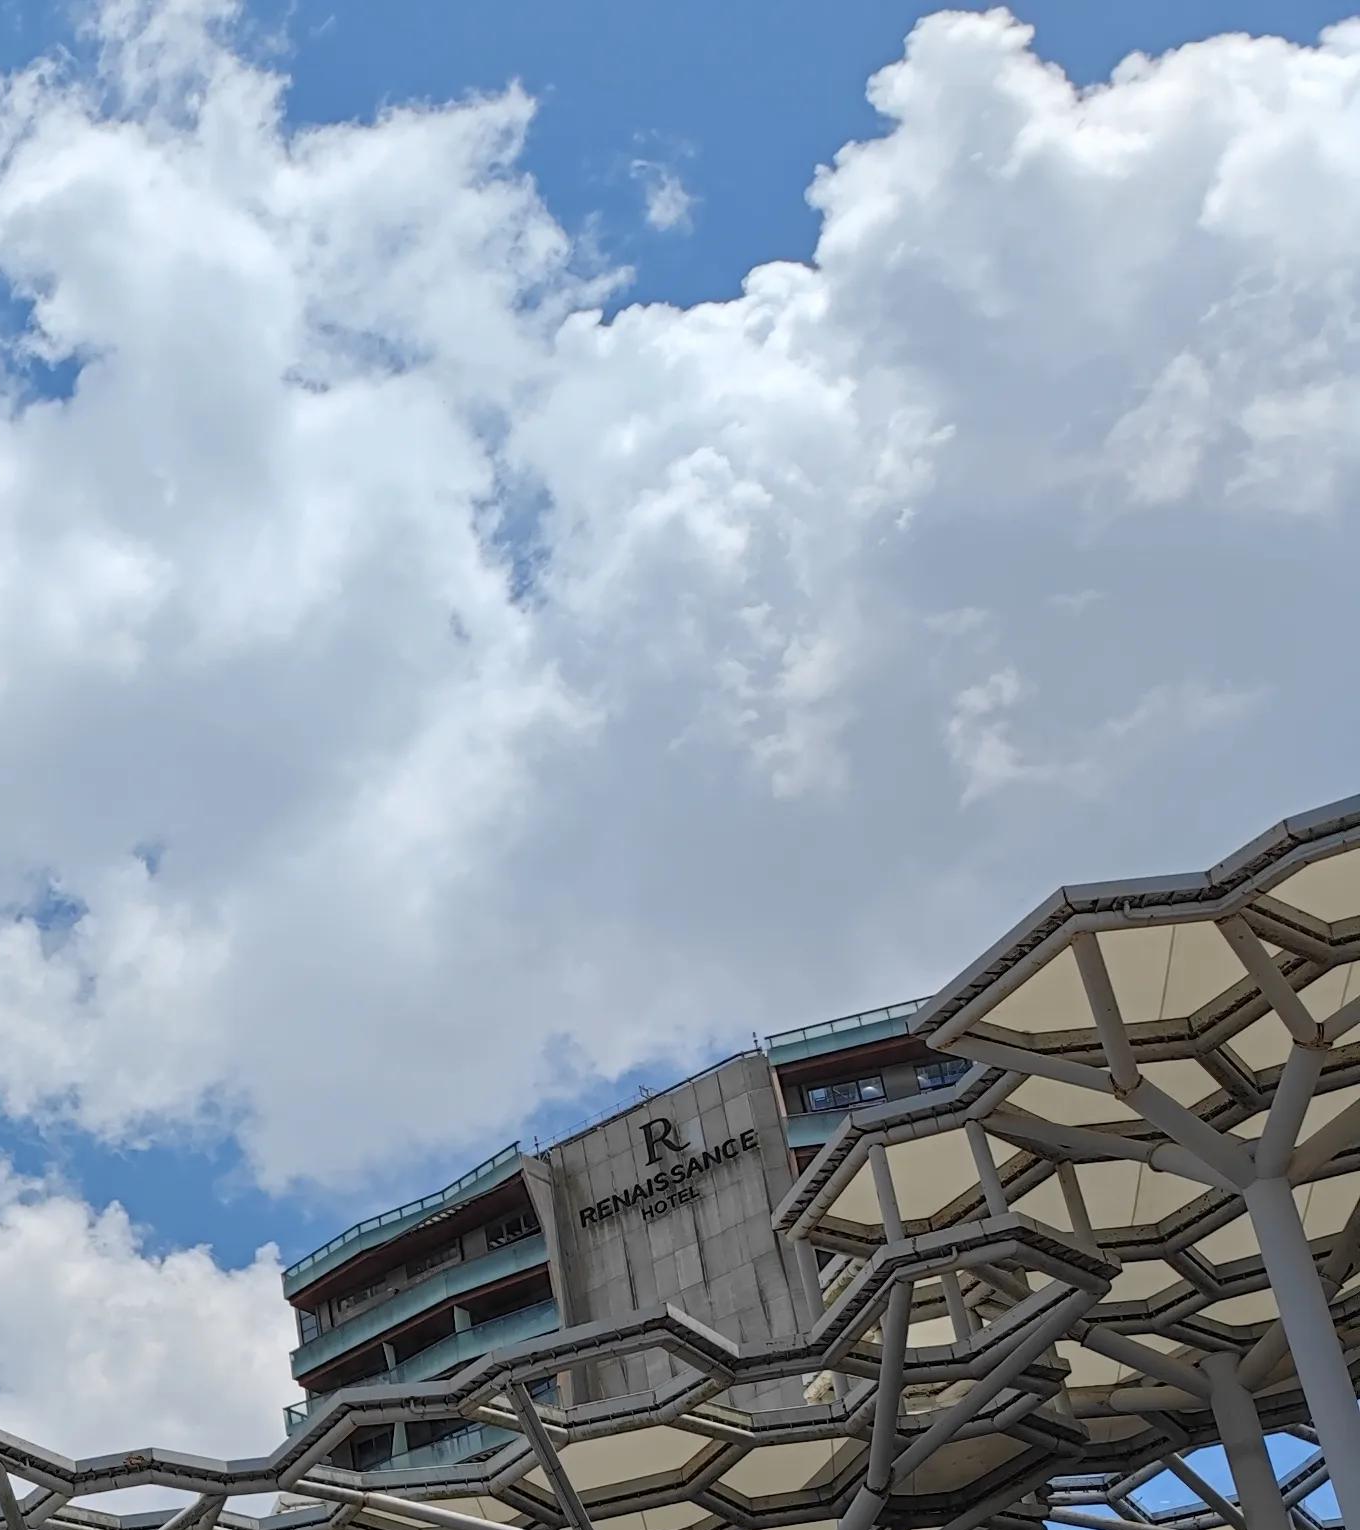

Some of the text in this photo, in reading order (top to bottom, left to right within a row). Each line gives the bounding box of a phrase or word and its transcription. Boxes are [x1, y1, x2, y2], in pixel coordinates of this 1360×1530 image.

[639, 1117, 691, 1166] R
[579, 1128, 760, 1229] RENAISSANCE
[641, 1186, 700, 1221] HOTEL
